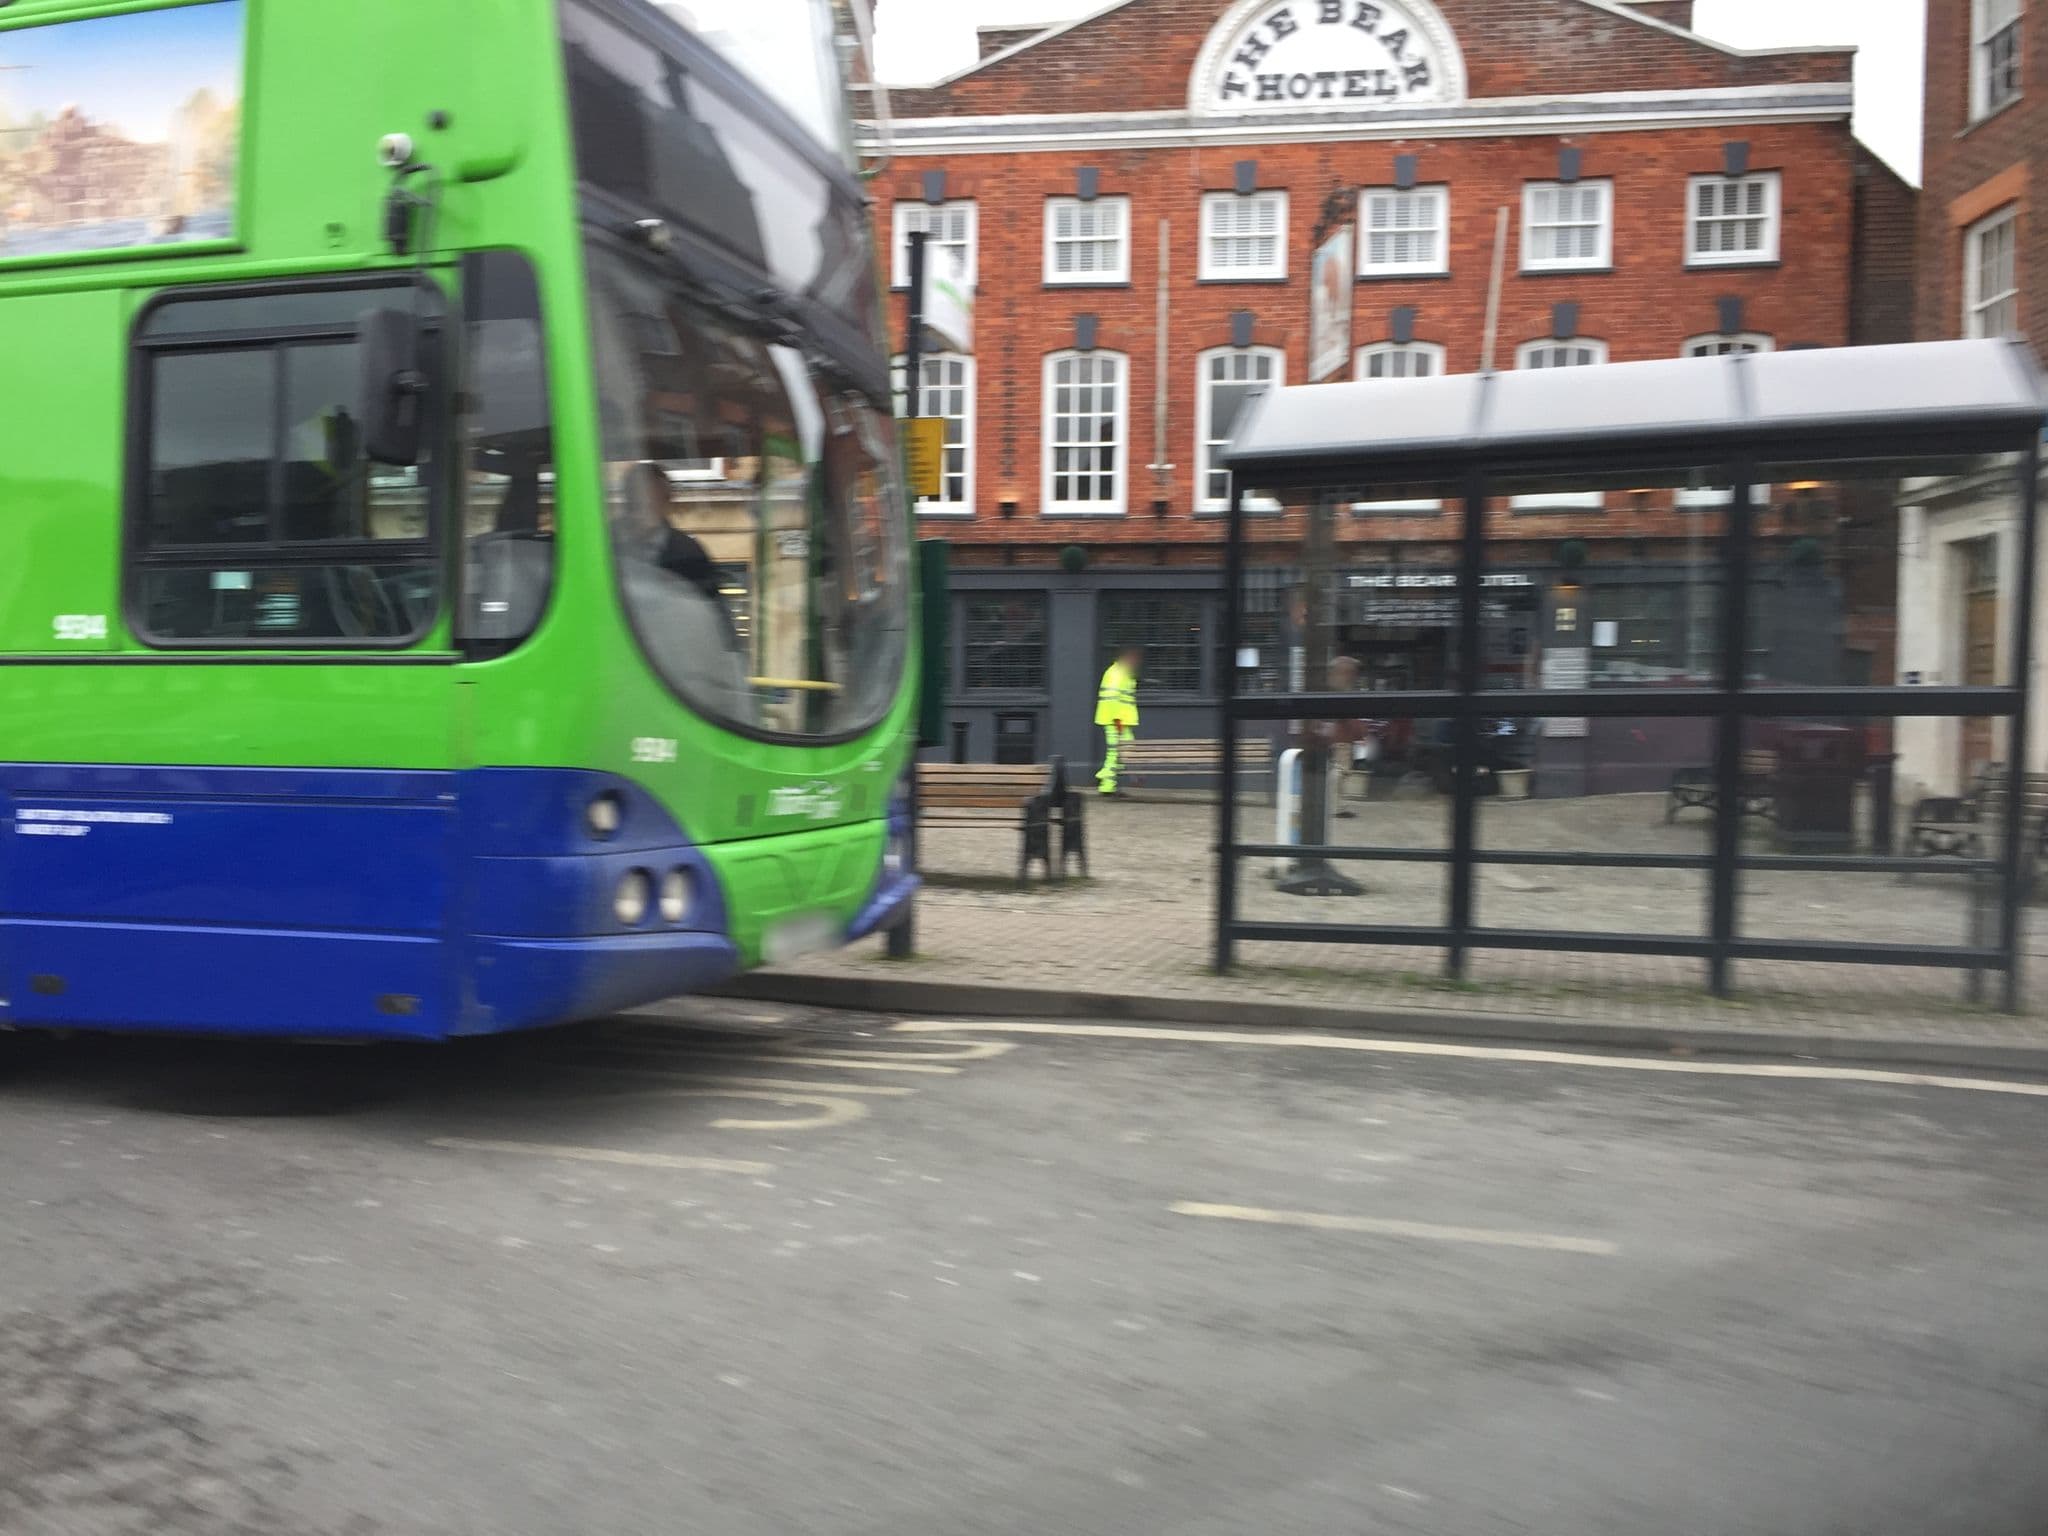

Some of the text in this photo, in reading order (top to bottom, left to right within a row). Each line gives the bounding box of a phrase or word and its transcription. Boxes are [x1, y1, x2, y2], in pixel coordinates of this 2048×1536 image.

[1221, 0, 1431, 101] THE BEAR
[1255, 69, 1397, 101] HOTEL
[1347, 575, 1394, 587] THE
[1395, 575, 1457, 587] BEAR
